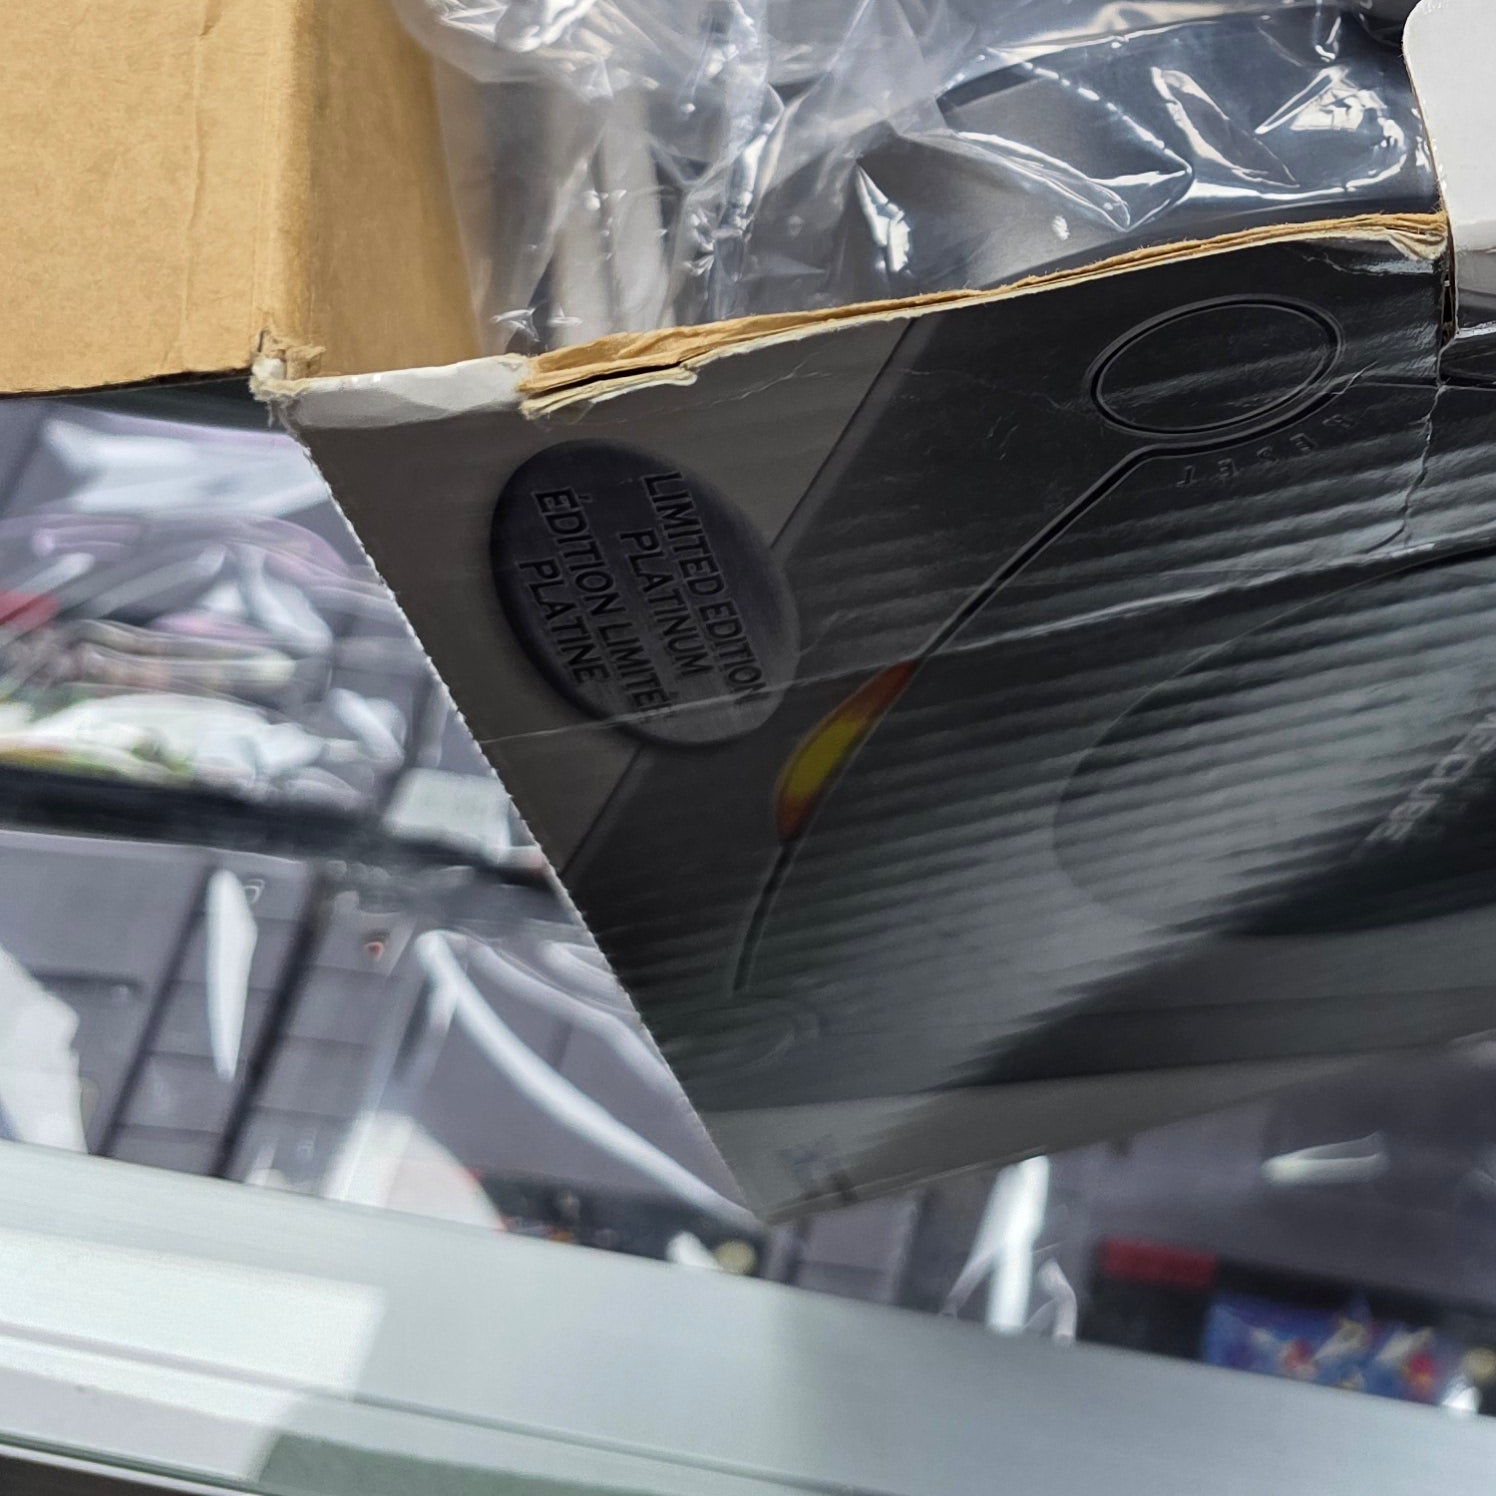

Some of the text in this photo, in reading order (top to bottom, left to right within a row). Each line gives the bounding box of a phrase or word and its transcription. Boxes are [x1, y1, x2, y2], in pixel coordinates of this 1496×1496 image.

[517, 558, 611, 686] PLATINE
[533, 487, 627, 619] ÉDITION
[619, 528, 718, 678] PLATINUM
[642, 471, 770, 706] LIMITED EDITION
